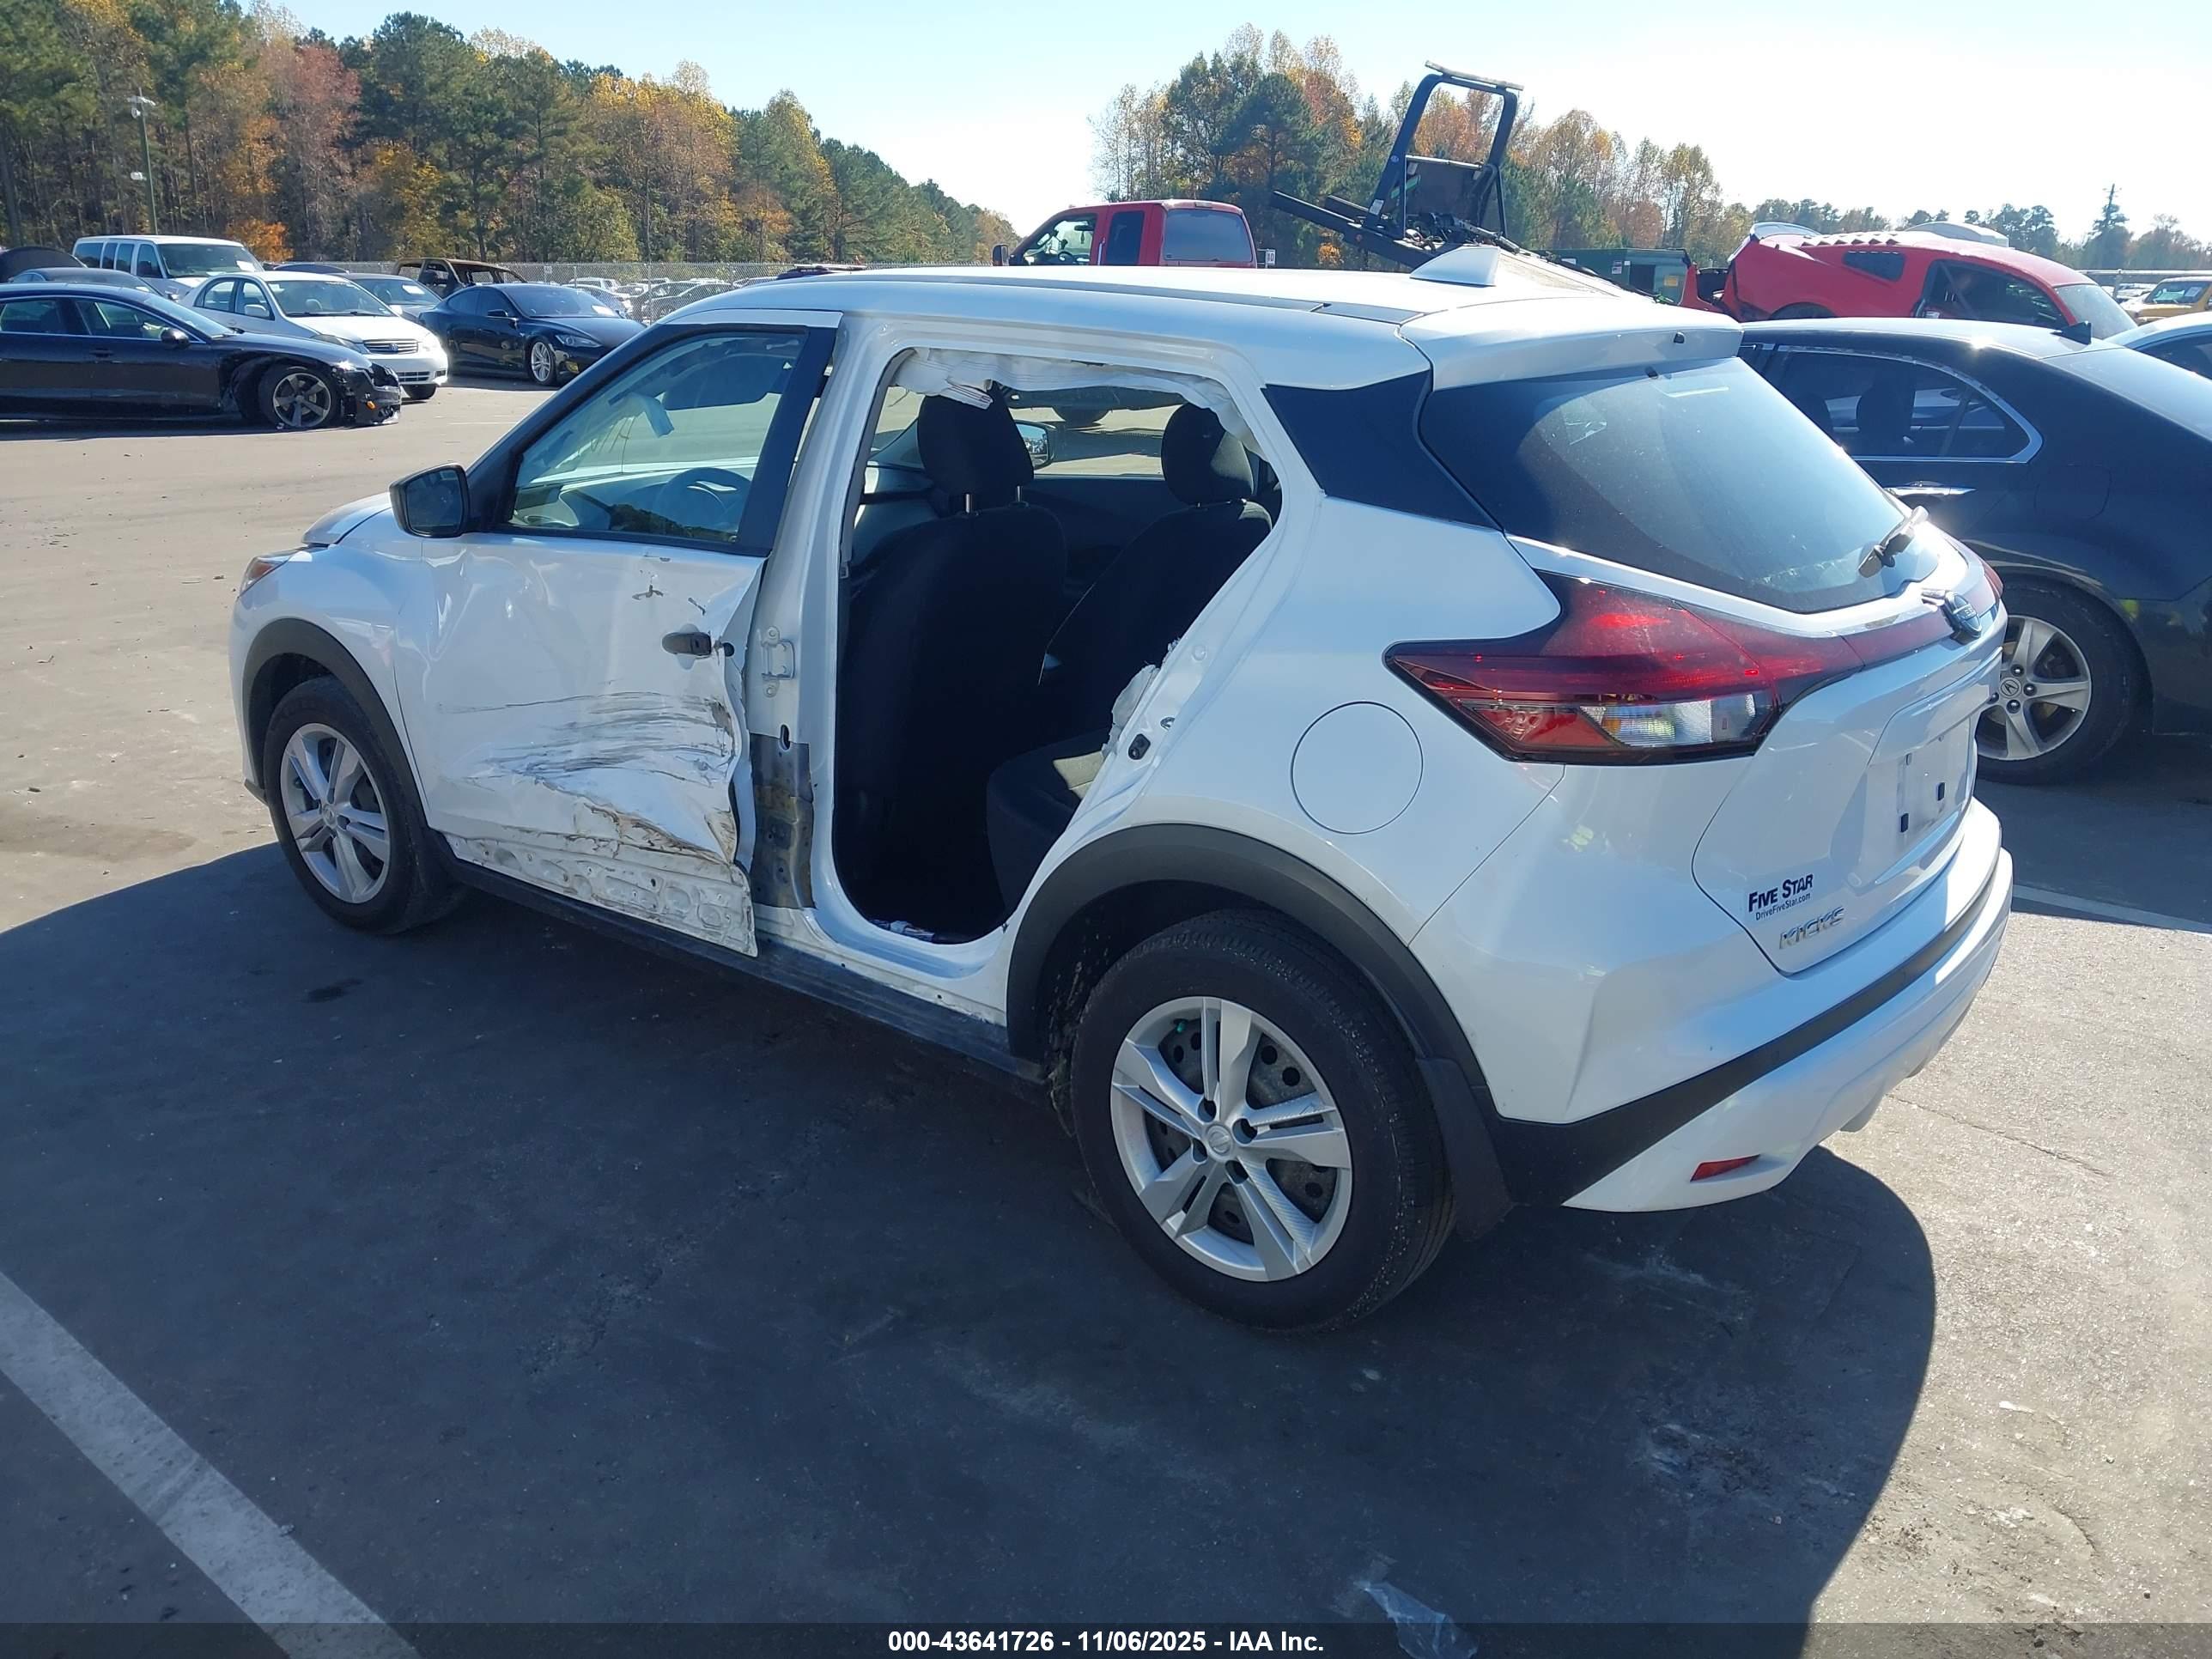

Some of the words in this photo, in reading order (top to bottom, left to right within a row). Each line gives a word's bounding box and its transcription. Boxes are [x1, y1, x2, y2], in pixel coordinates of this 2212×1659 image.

[1748, 887, 1778, 912] FIVE
[1782, 873, 1814, 899] STAR
[1755, 892, 1811, 921] DriveFiveStar.com
[1779, 906, 1844, 949] KICKS
